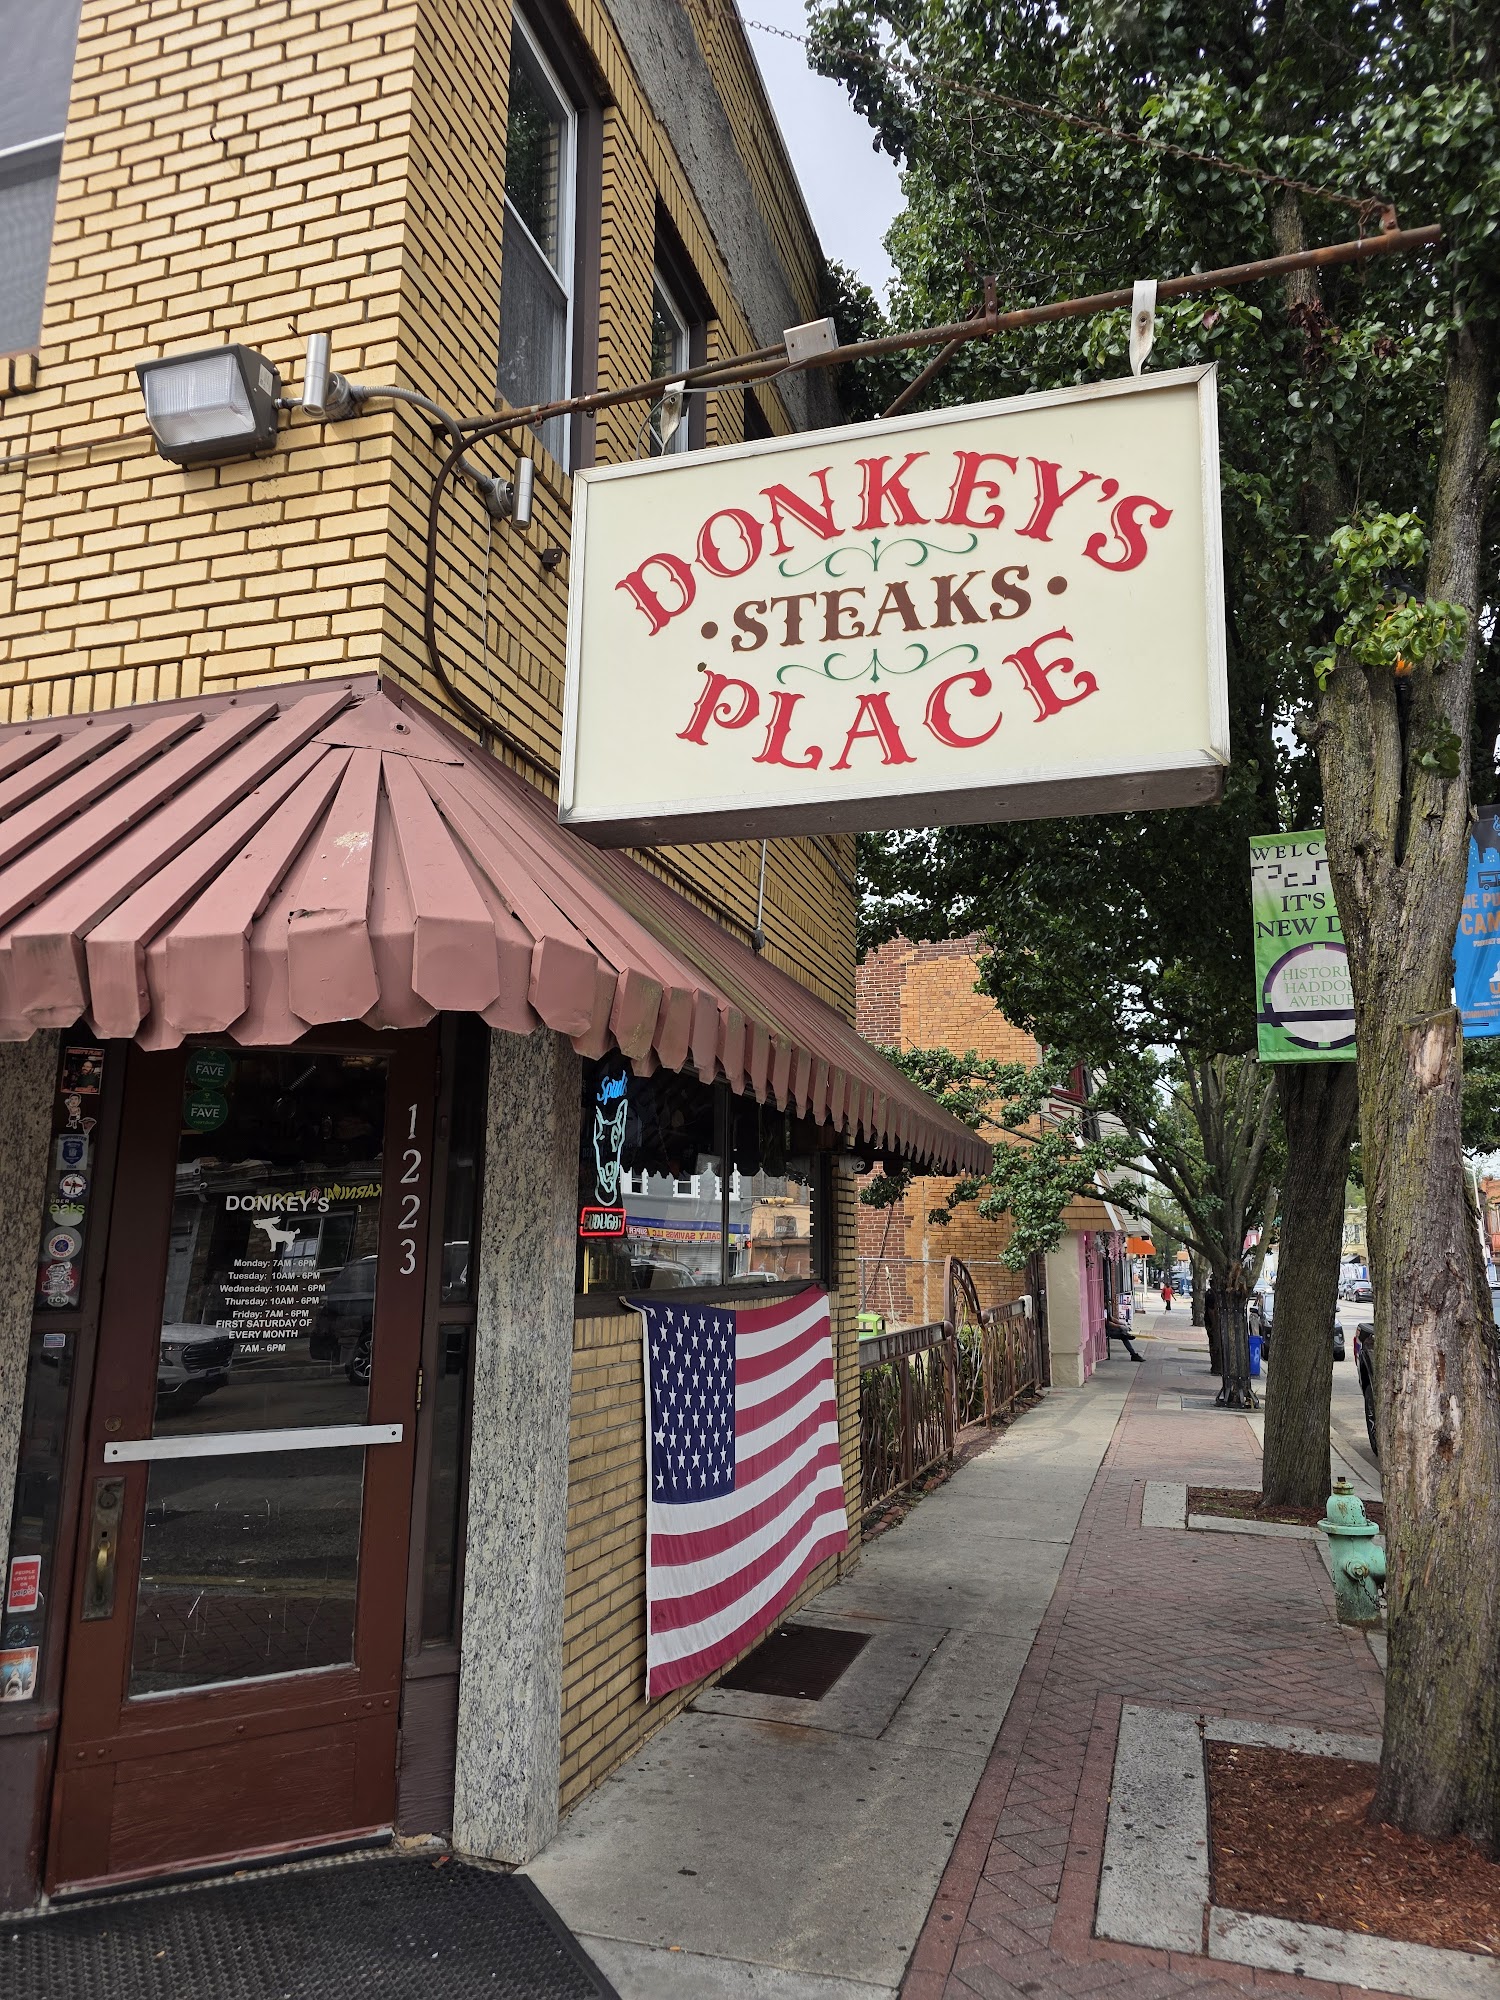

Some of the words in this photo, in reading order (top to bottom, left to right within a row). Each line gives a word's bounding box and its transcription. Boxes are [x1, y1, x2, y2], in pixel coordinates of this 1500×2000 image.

[614, 450, 1173, 636] DONKEY'S
[730, 565, 1032, 653] STEAKS
[676, 626, 1099, 771] PLACE
[1251, 842, 1324, 861] WELC
[1281, 892, 1326, 912] IT'S
[1256, 917, 1318, 938] NEW
[1289, 993, 1354, 1008] AVENUE
[196, 1064, 225, 1076] FAVE
[190, 1108, 220, 1118] FAVE
[398, 1103, 422, 1275] 1223
[49, 1203, 85, 1215] eats
[226, 1196, 330, 1212] DONKEY'S
[234, 1259, 270, 1268] Monday:
[228, 1272, 267, 1281] Tuesday:
[220, 1284, 272, 1294] Wednesday:
[225, 1298, 268, 1306] Thursday:
[232, 1310, 262, 1319] Friday:
[216, 1320, 244, 1328] FIRST
[246, 1319, 297, 1328] SATURDAY
[229, 1330, 261, 1339] EVERY
[263, 1330, 298, 1338] MONTH
[12, 1588, 27, 1598] yelp
